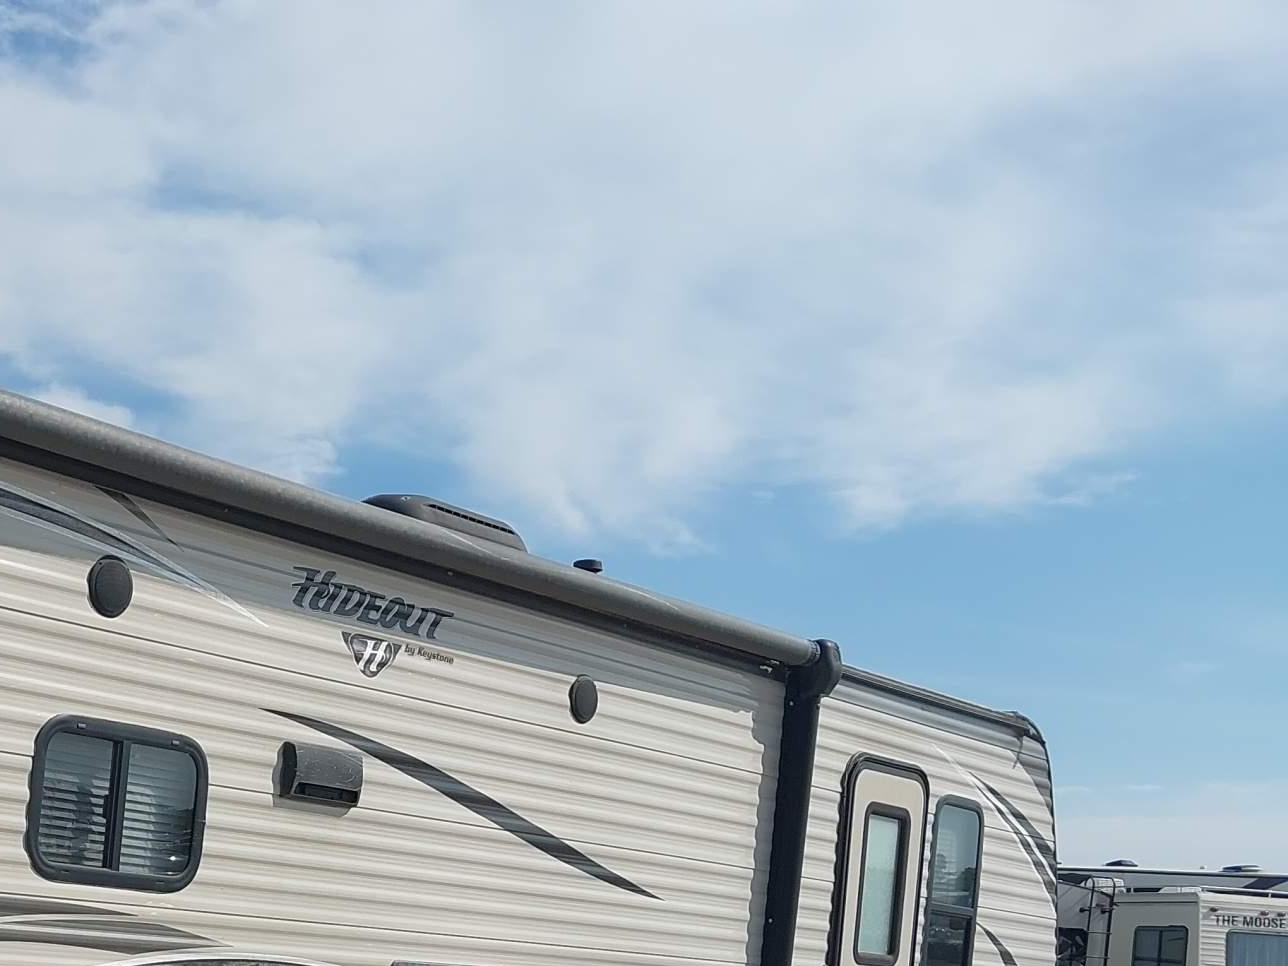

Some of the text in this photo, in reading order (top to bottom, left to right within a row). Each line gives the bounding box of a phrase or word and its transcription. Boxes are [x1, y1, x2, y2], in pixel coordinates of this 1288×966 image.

[292, 566, 454, 639] HIDEOUT
[404, 645, 454, 665] by Keystone
[1214, 914, 1288, 929] THE MOOSE
